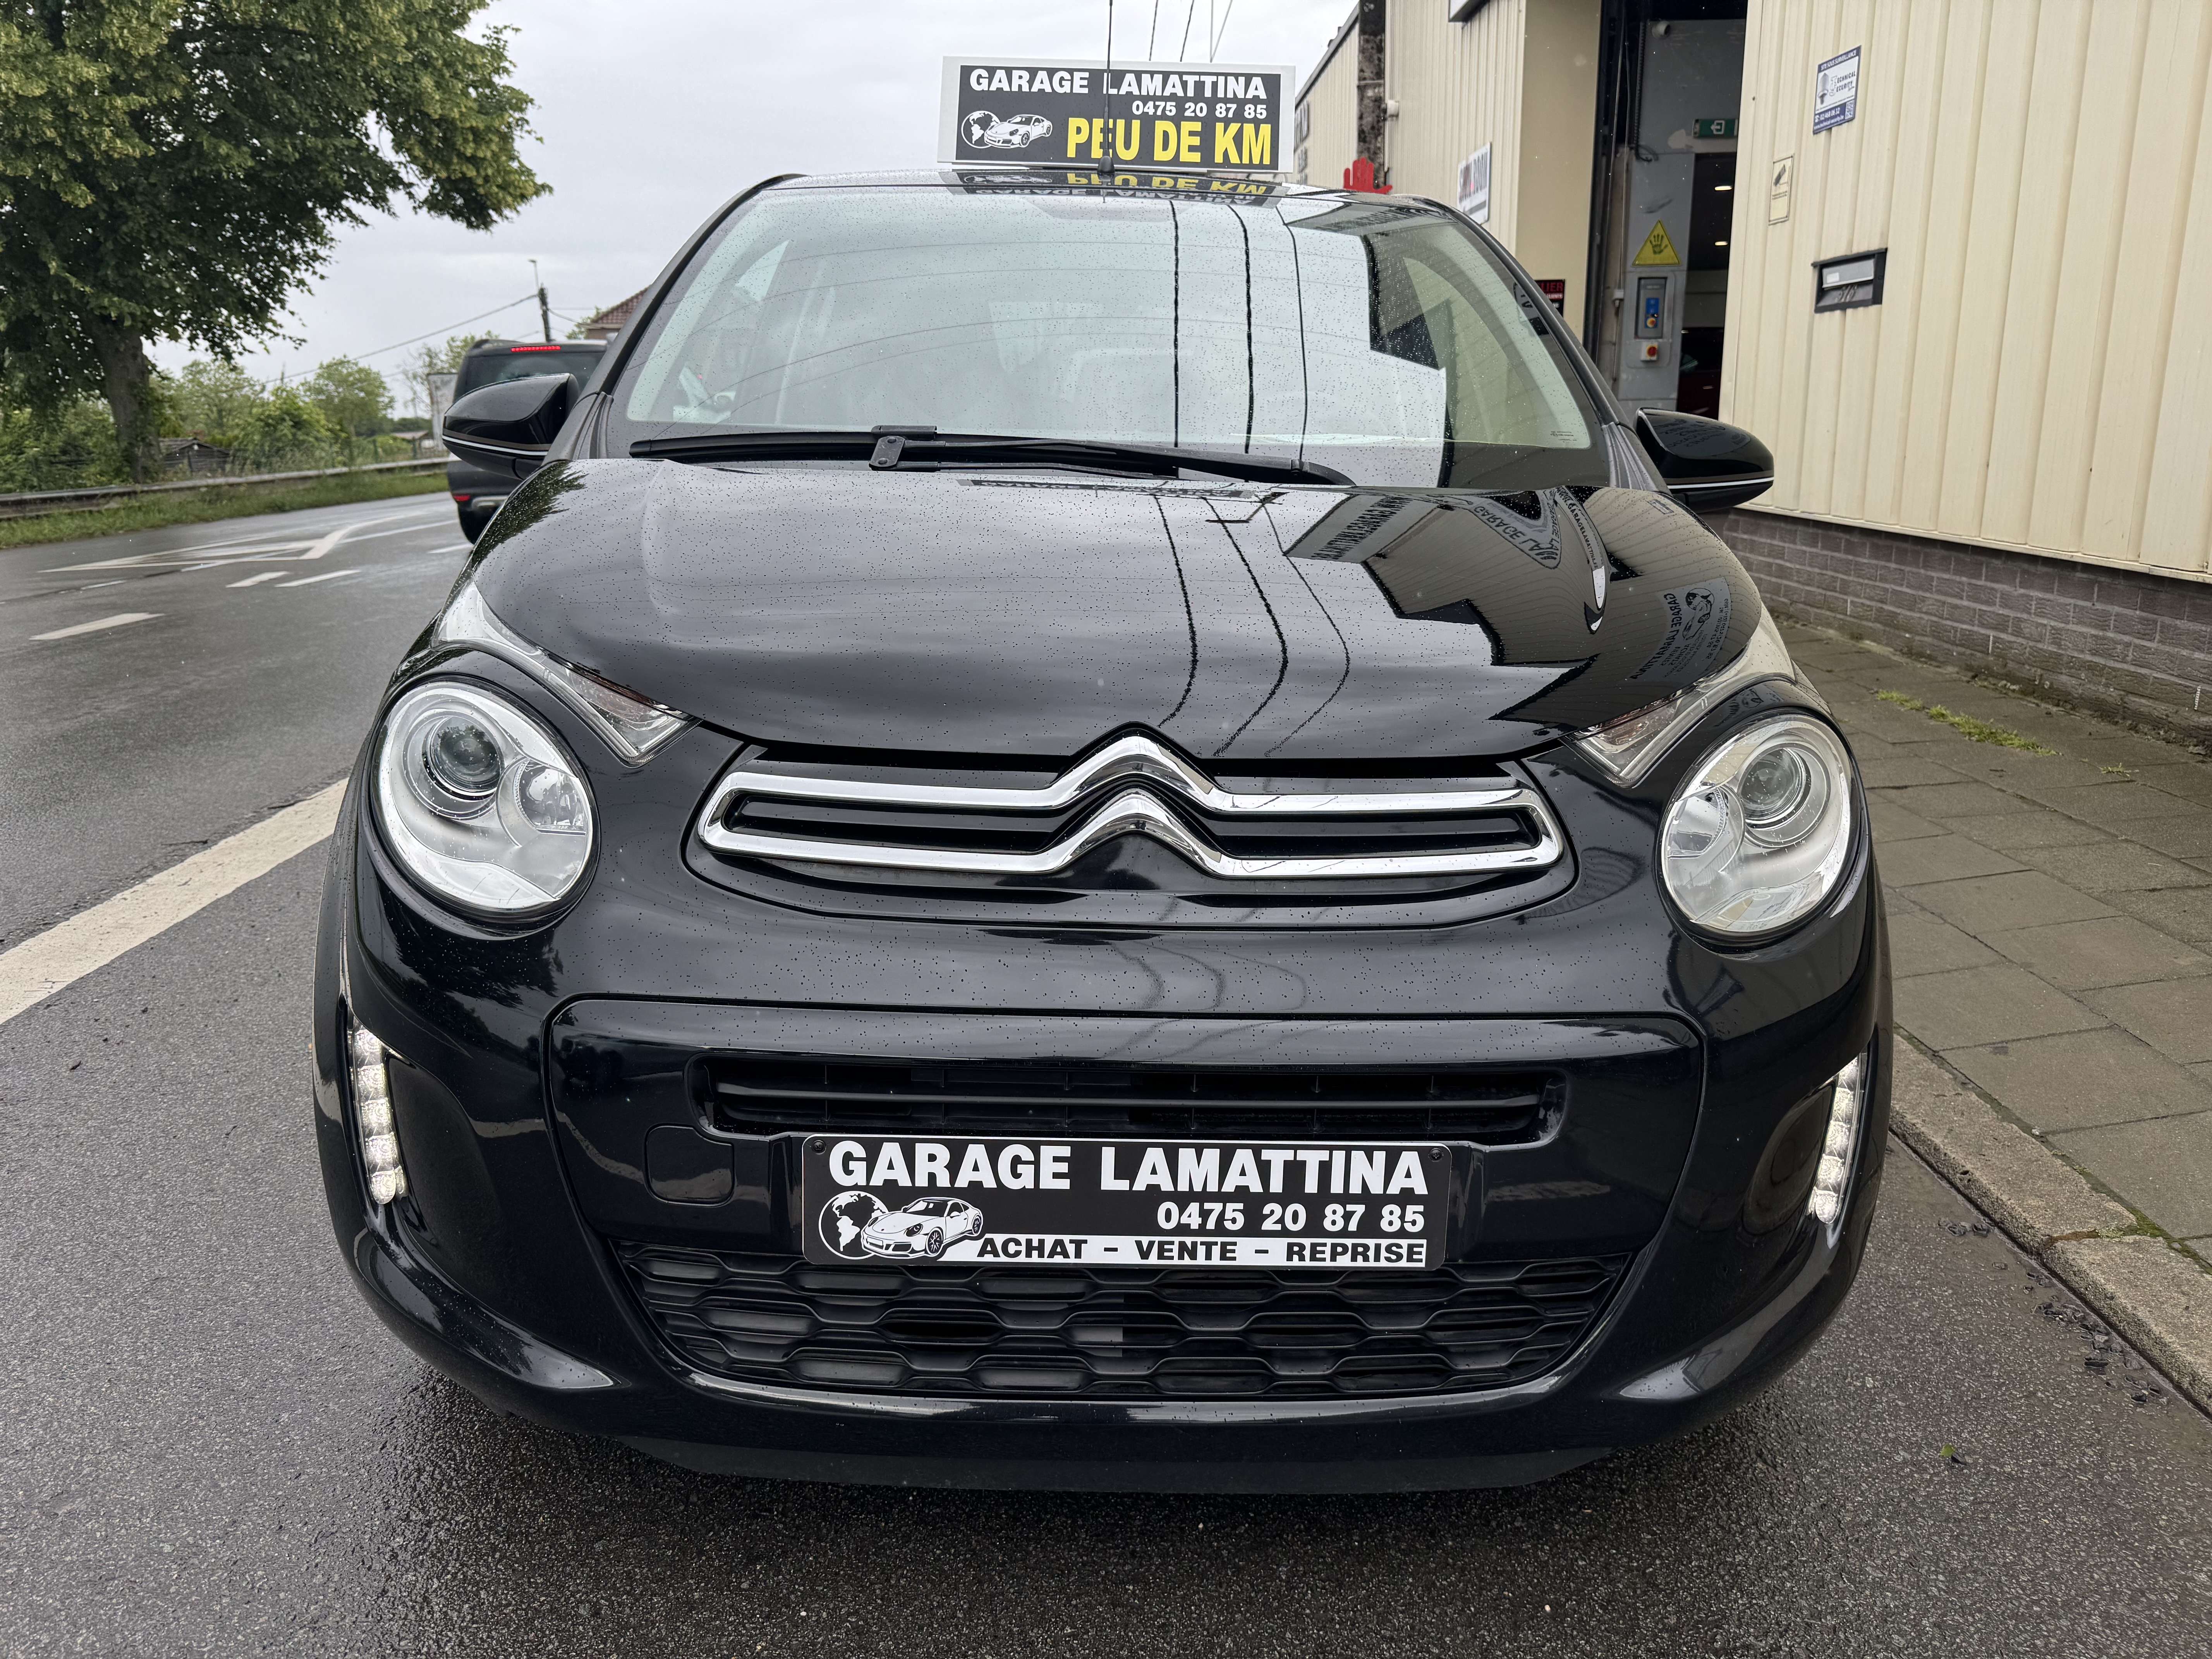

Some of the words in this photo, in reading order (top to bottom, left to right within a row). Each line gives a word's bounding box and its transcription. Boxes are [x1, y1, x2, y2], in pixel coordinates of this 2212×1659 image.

[970, 69, 1089, 94] GARAGE
[1103, 72, 1267, 99] LAMATTINA
[1132, 100, 1176, 116] 0475
[1184, 102, 1207, 117] 20
[1215, 103, 1237, 118] 87
[1244, 104, 1267, 119] 85
[1067, 117, 1140, 160] PEU
[1154, 120, 1202, 163] DE
[1214, 122, 1271, 165] KM
[829, 1140, 1071, 1190] GARAGE
[1100, 1146, 1428, 1195] LAMATTINA
[1157, 1201, 1245, 1230] 0475
[1261, 1203, 1306, 1231] 20
[1323, 1203, 1365, 1231] 87
[1380, 1204, 1424, 1232] 85
[977, 1237, 1088, 1259] ACHAT
[1135, 1240, 1237, 1261] VENTE
[1286, 1242, 1424, 1263] REPRISE
